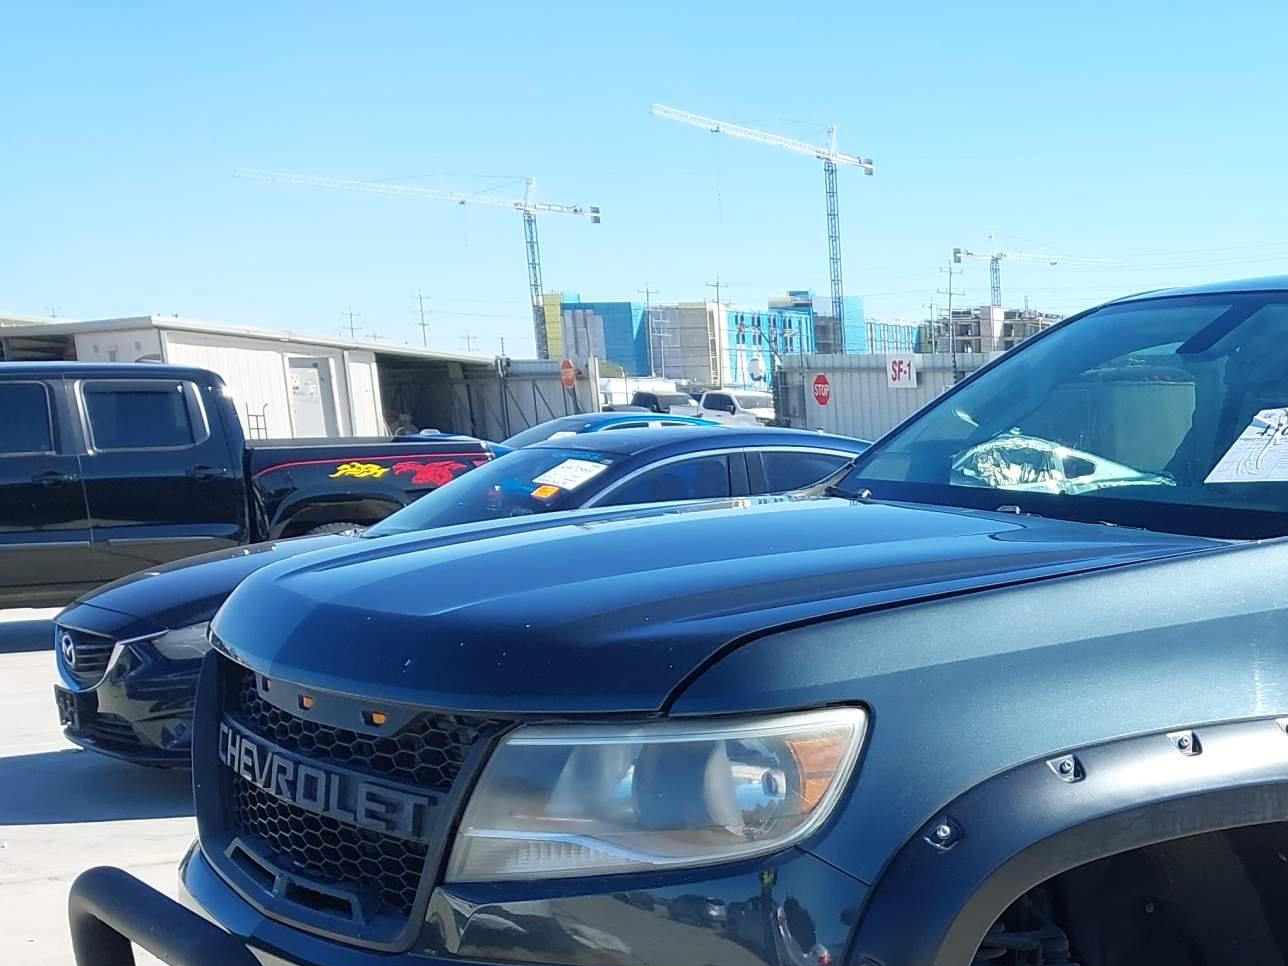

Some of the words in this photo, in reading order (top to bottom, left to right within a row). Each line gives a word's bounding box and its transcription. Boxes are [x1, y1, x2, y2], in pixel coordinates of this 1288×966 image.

[891, 360, 912, 382] SF-1
[814, 383, 830, 397] STOP
[219, 722, 431, 841] CHEVROLET
